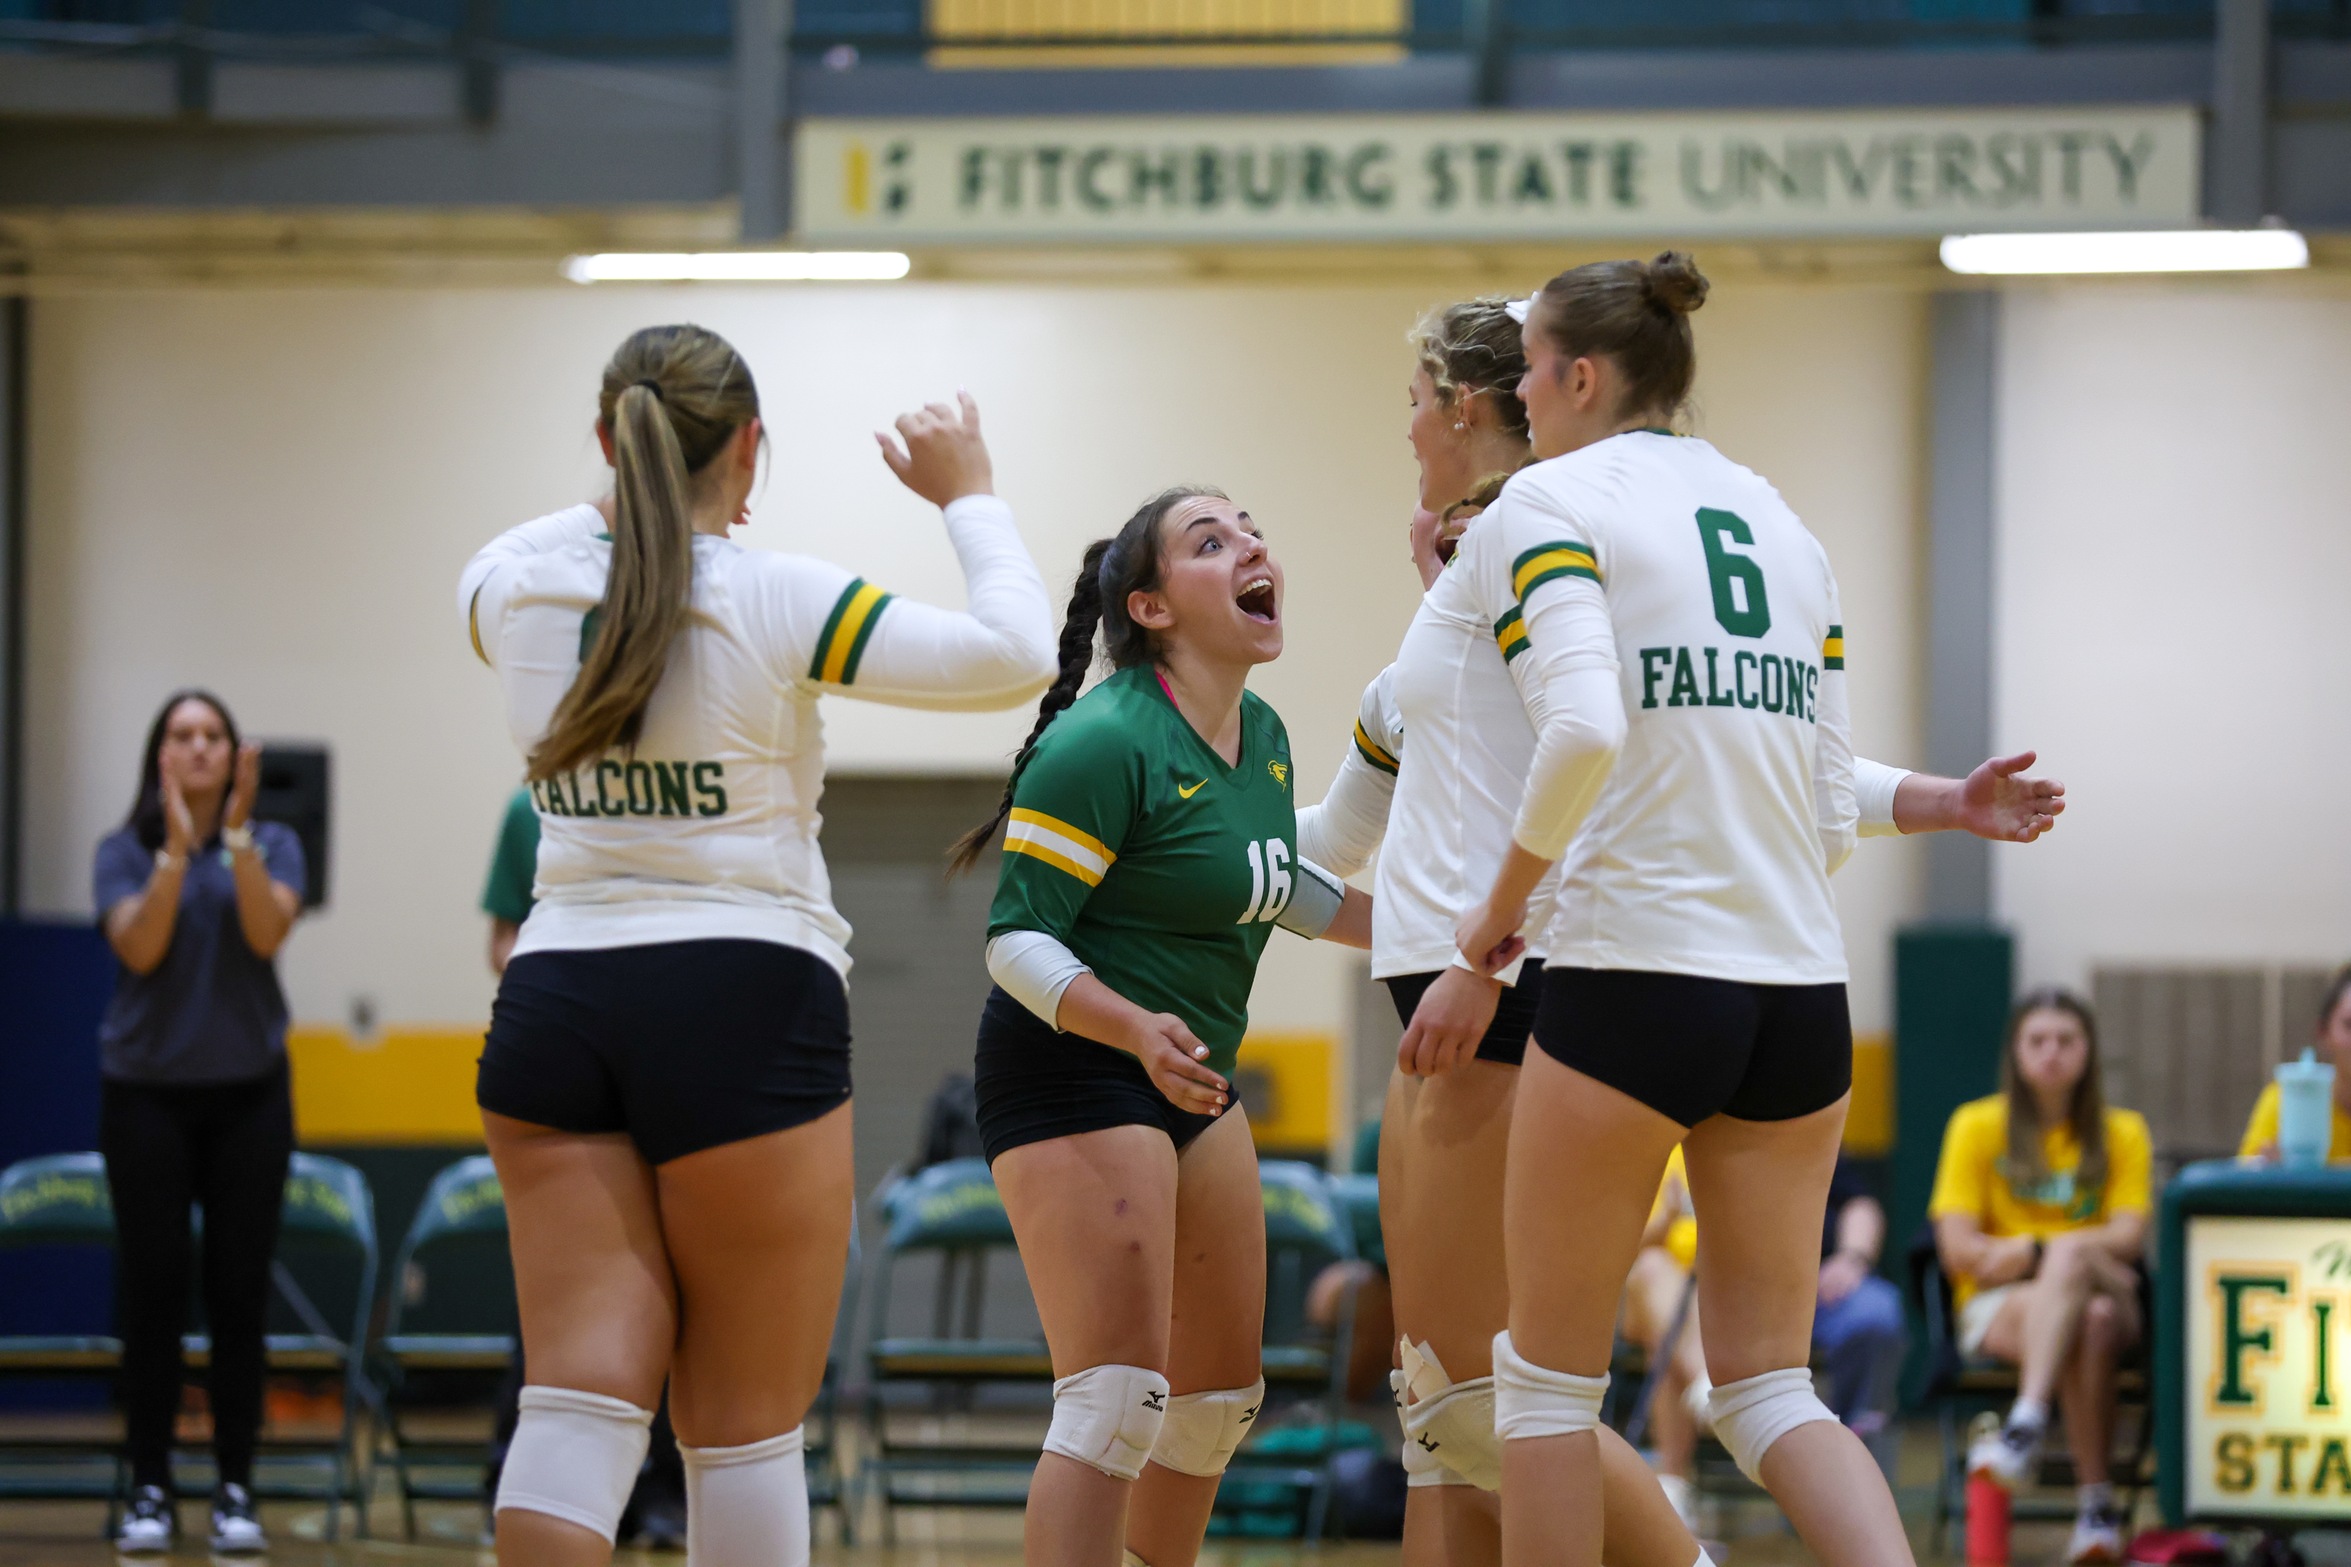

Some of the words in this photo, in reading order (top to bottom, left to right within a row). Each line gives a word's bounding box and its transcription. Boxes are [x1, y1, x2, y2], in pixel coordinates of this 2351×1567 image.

[957, 142, 1396, 211] FITCHBURG
[1424, 139, 1645, 211] STATE
[1677, 129, 2156, 209] UNIVERSITY
[1695, 506, 1771, 639] 6
[1640, 646, 1818, 724] FALCONS
[1236, 837, 1291, 925] 16
[2205, 1260, 2351, 1420] FI
[2214, 1431, 2351, 1495] STA
